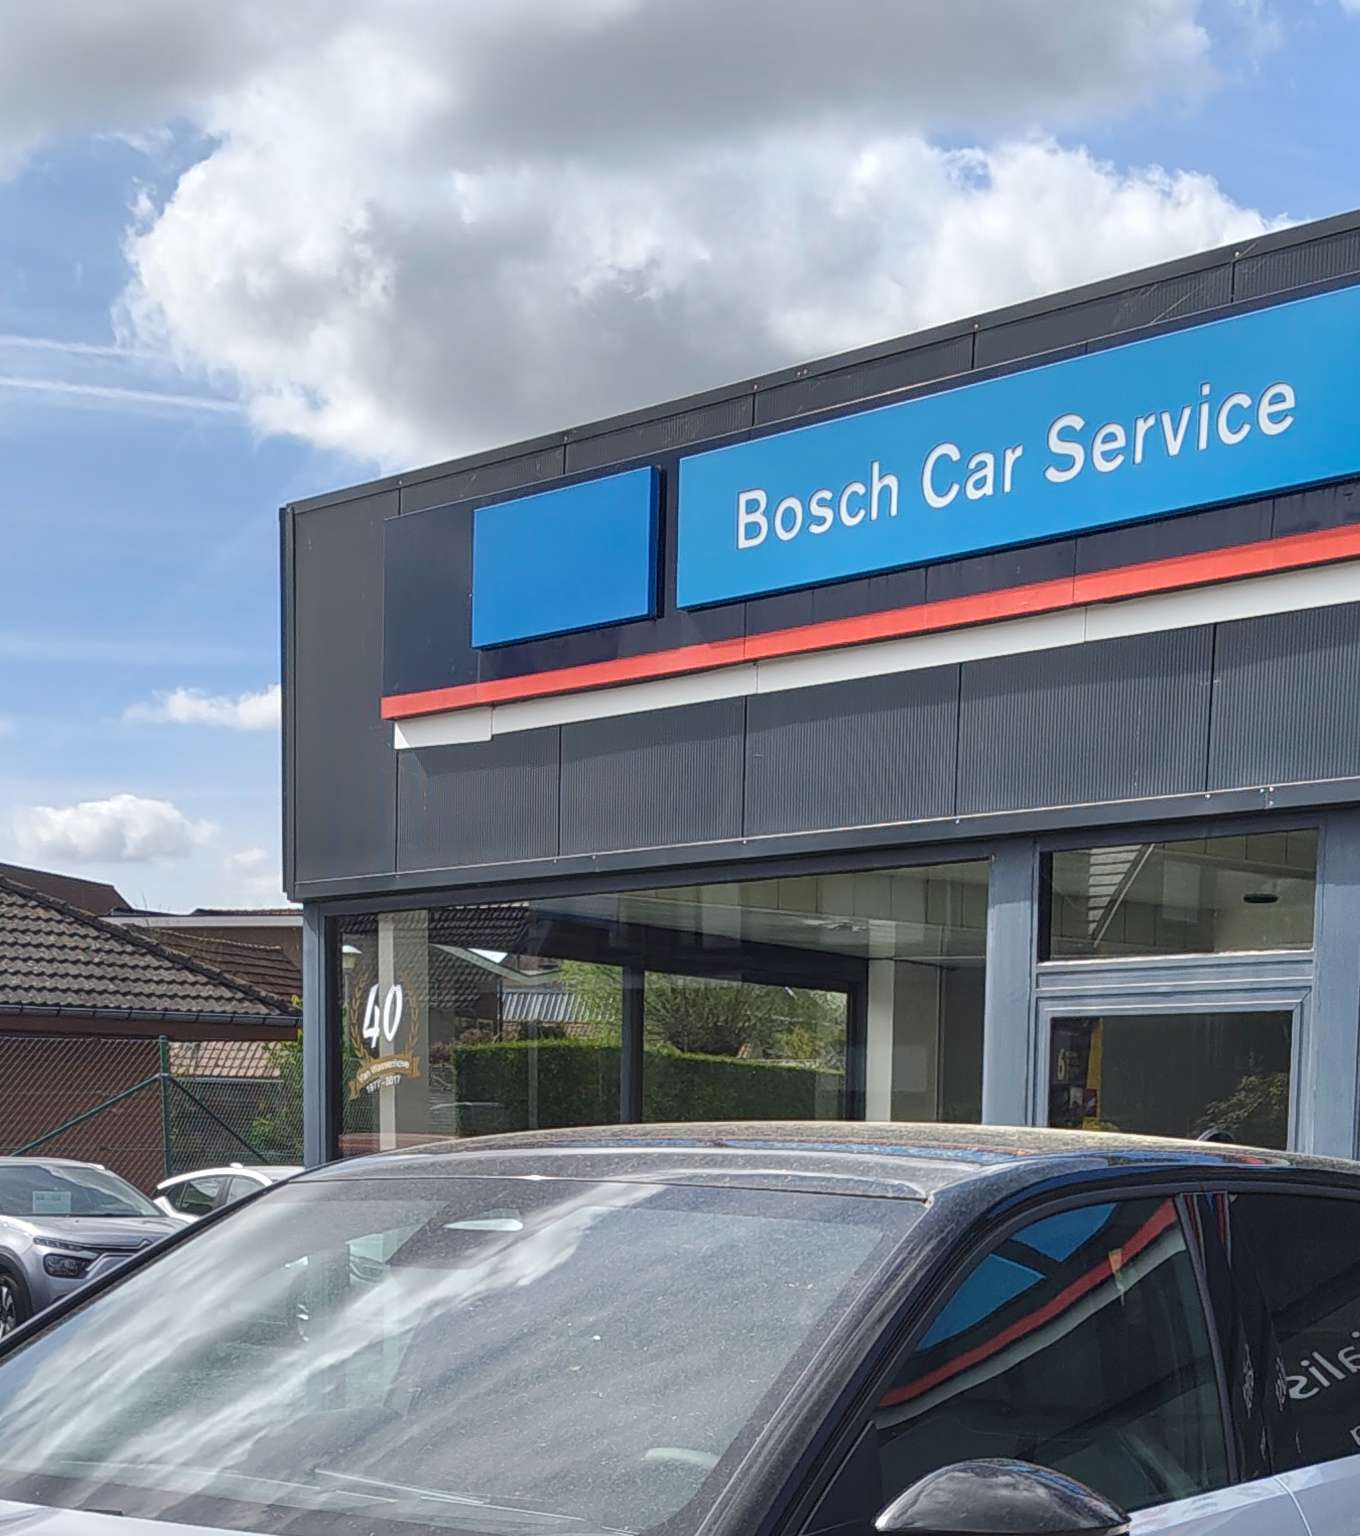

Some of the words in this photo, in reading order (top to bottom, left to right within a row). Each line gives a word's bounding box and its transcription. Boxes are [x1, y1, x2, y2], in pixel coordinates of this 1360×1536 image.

[737, 461, 898, 550] Bosch
[922, 443, 1023, 509] Car
[1044, 382, 1296, 484] Service
[362, 983, 403, 1049] 40
